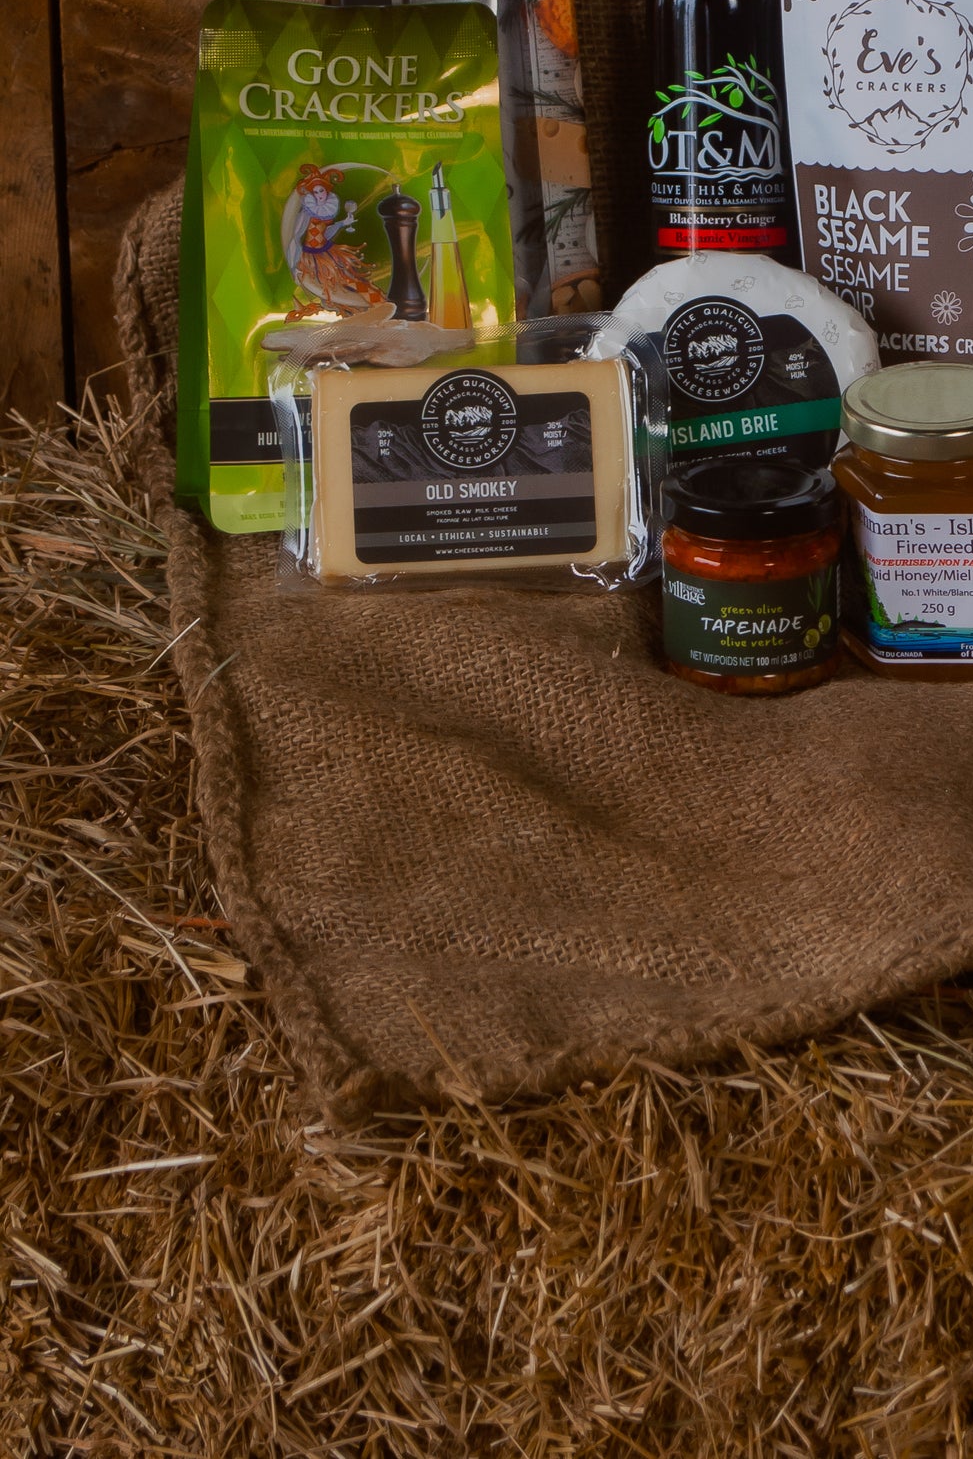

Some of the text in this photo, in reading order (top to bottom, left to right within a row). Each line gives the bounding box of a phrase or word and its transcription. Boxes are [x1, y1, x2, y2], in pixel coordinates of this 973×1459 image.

[856, 28, 942, 75] Eve's
[288, 49, 418, 86] GONE
[856, 81, 946, 93] CRACKERS
[238, 83, 465, 124] CRACKERS
[648, 130, 778, 170] OT&M
[651, 182, 785, 195] OLIVE THIS & MORE
[695, 197, 711, 205] OILS
[722, 197, 757, 205] BALSAMIC
[814, 184, 912, 223] BLACK
[669, 212, 776, 228] Blackberry Ginger
[817, 217, 930, 257] SESAME
[821, 248, 910, 292] SÉSAME
[669, 308, 756, 347] LITTLE QUALICUM
[687, 320, 738, 338] HANDCRAFTED
[677, 361, 757, 397] CHEESEWORKS
[428, 380, 511, 414] LITTLE QUALICUM
[446, 391, 493, 407] HANDCRAFTED
[672, 413, 779, 445] ISLAND BRIE
[432, 434, 509, 464] CHEESEWORKS
[449, 438, 493, 452] GRASS-FED
[756, 445, 788, 457] CHEESE
[426, 480, 518, 500] OLD SMOKEY
[399, 527, 549, 543] LOCAL ETHICAL SUSTAINABLE
[435, 545, 514, 555] WWW.CHEESEWORKS.CA
[894, 570, 971, 584] Honey/Miel
[668, 580, 706, 606] village
[901, 588, 973, 597] No.1 White/Blanc
[720, 604, 783, 619] green olive
[921, 603, 955, 616] 250 g
[701, 615, 804, 635] TAPENADE
[720, 636, 784, 648] olive verte
[690, 649, 770, 667] NET WT/POIDS NET 100
[960, 650, 969, 658] of
